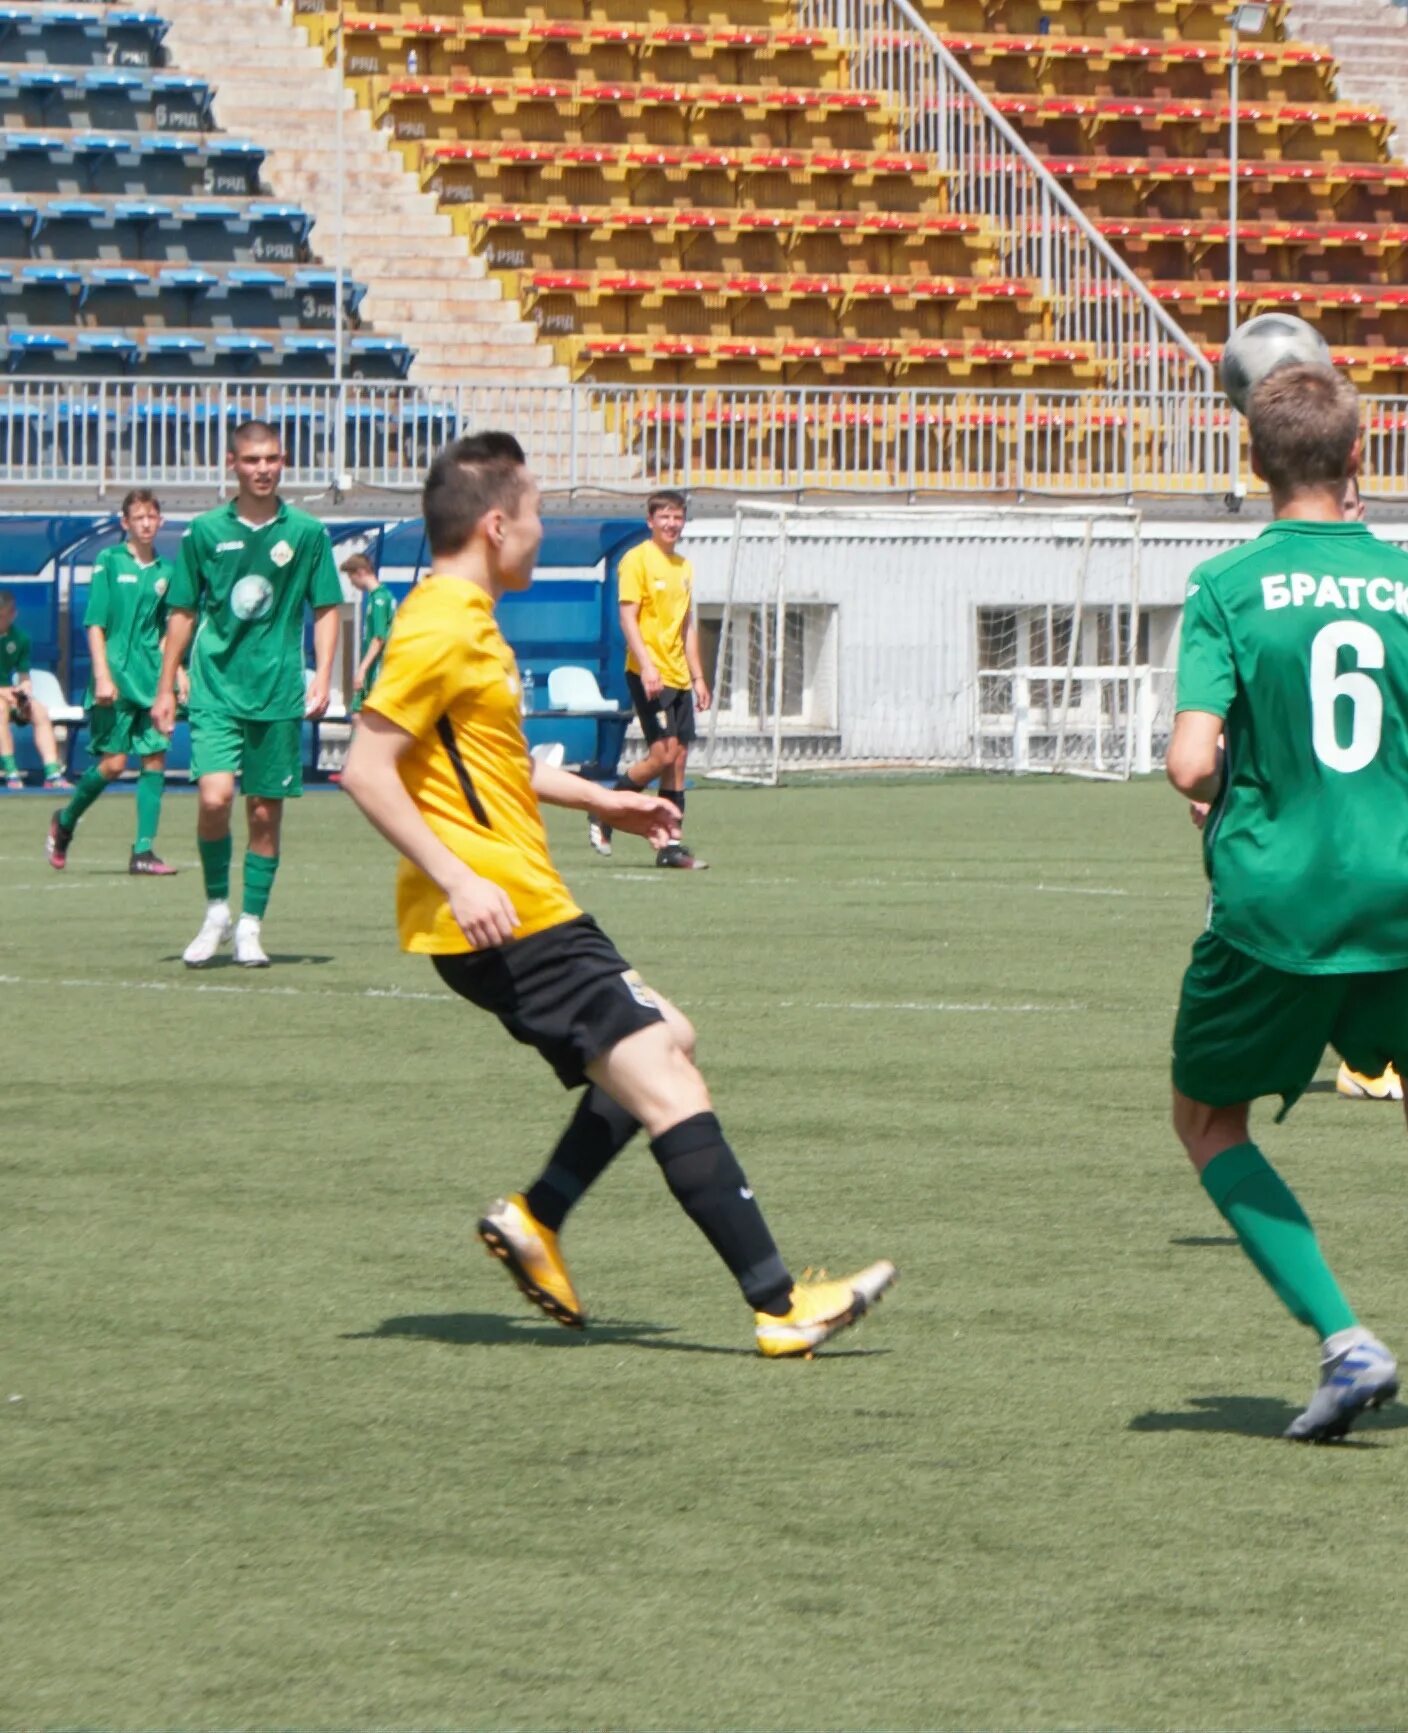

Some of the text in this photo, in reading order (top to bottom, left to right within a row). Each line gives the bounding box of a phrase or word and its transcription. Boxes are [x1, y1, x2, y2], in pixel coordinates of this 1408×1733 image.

[107, 42, 118, 65] 7
[156, 104, 198, 127] 6 РЯД
[203, 168, 246, 191] 5 РЯД
[251, 236, 294, 258] 4 РЯД
[483, 243, 495, 264] 4
[302, 295, 316, 318] 3
[546, 315, 574, 330] РЯД
[1310, 619, 1385, 773] 6
